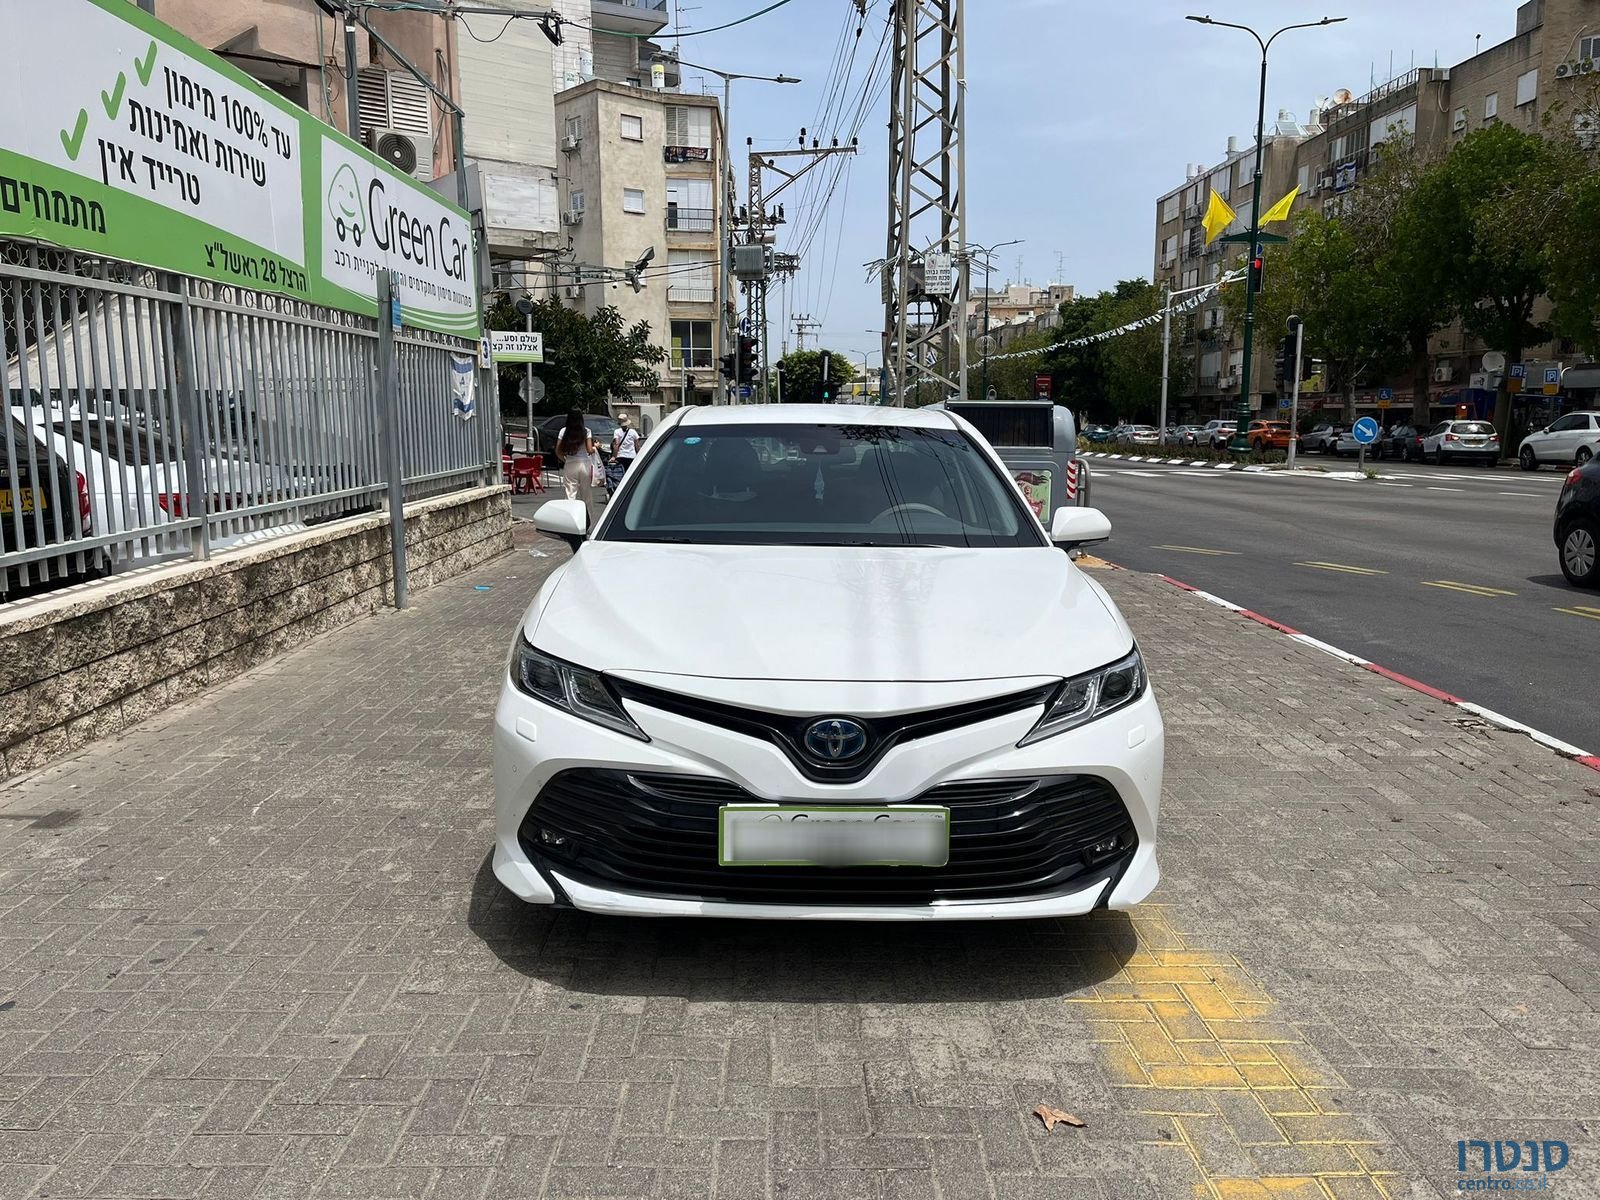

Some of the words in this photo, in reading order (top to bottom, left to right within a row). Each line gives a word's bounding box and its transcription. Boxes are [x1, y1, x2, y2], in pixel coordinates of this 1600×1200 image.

[164, 66, 216, 121] מימון
[128, 98, 210, 163] ואמינות
[221, 95, 268, 147] 100%
[271, 126, 291, 160] עד
[98, 138, 137, 186] אין
[142, 155, 201, 205] טרייד
[214, 138, 266, 187] שירות
[0, 175, 106, 234] מתמחים
[368, 178, 437, 270] Green
[439, 216, 468, 282] Car
[261, 257, 277, 284] 28
[279, 261, 307, 292] הרצל
[334, 249, 351, 269] רכב
[408, 275, 436, 297] מתקדמים
[516, 343, 538, 351] אצלנו
[520, 334, 537, 343] שלם
